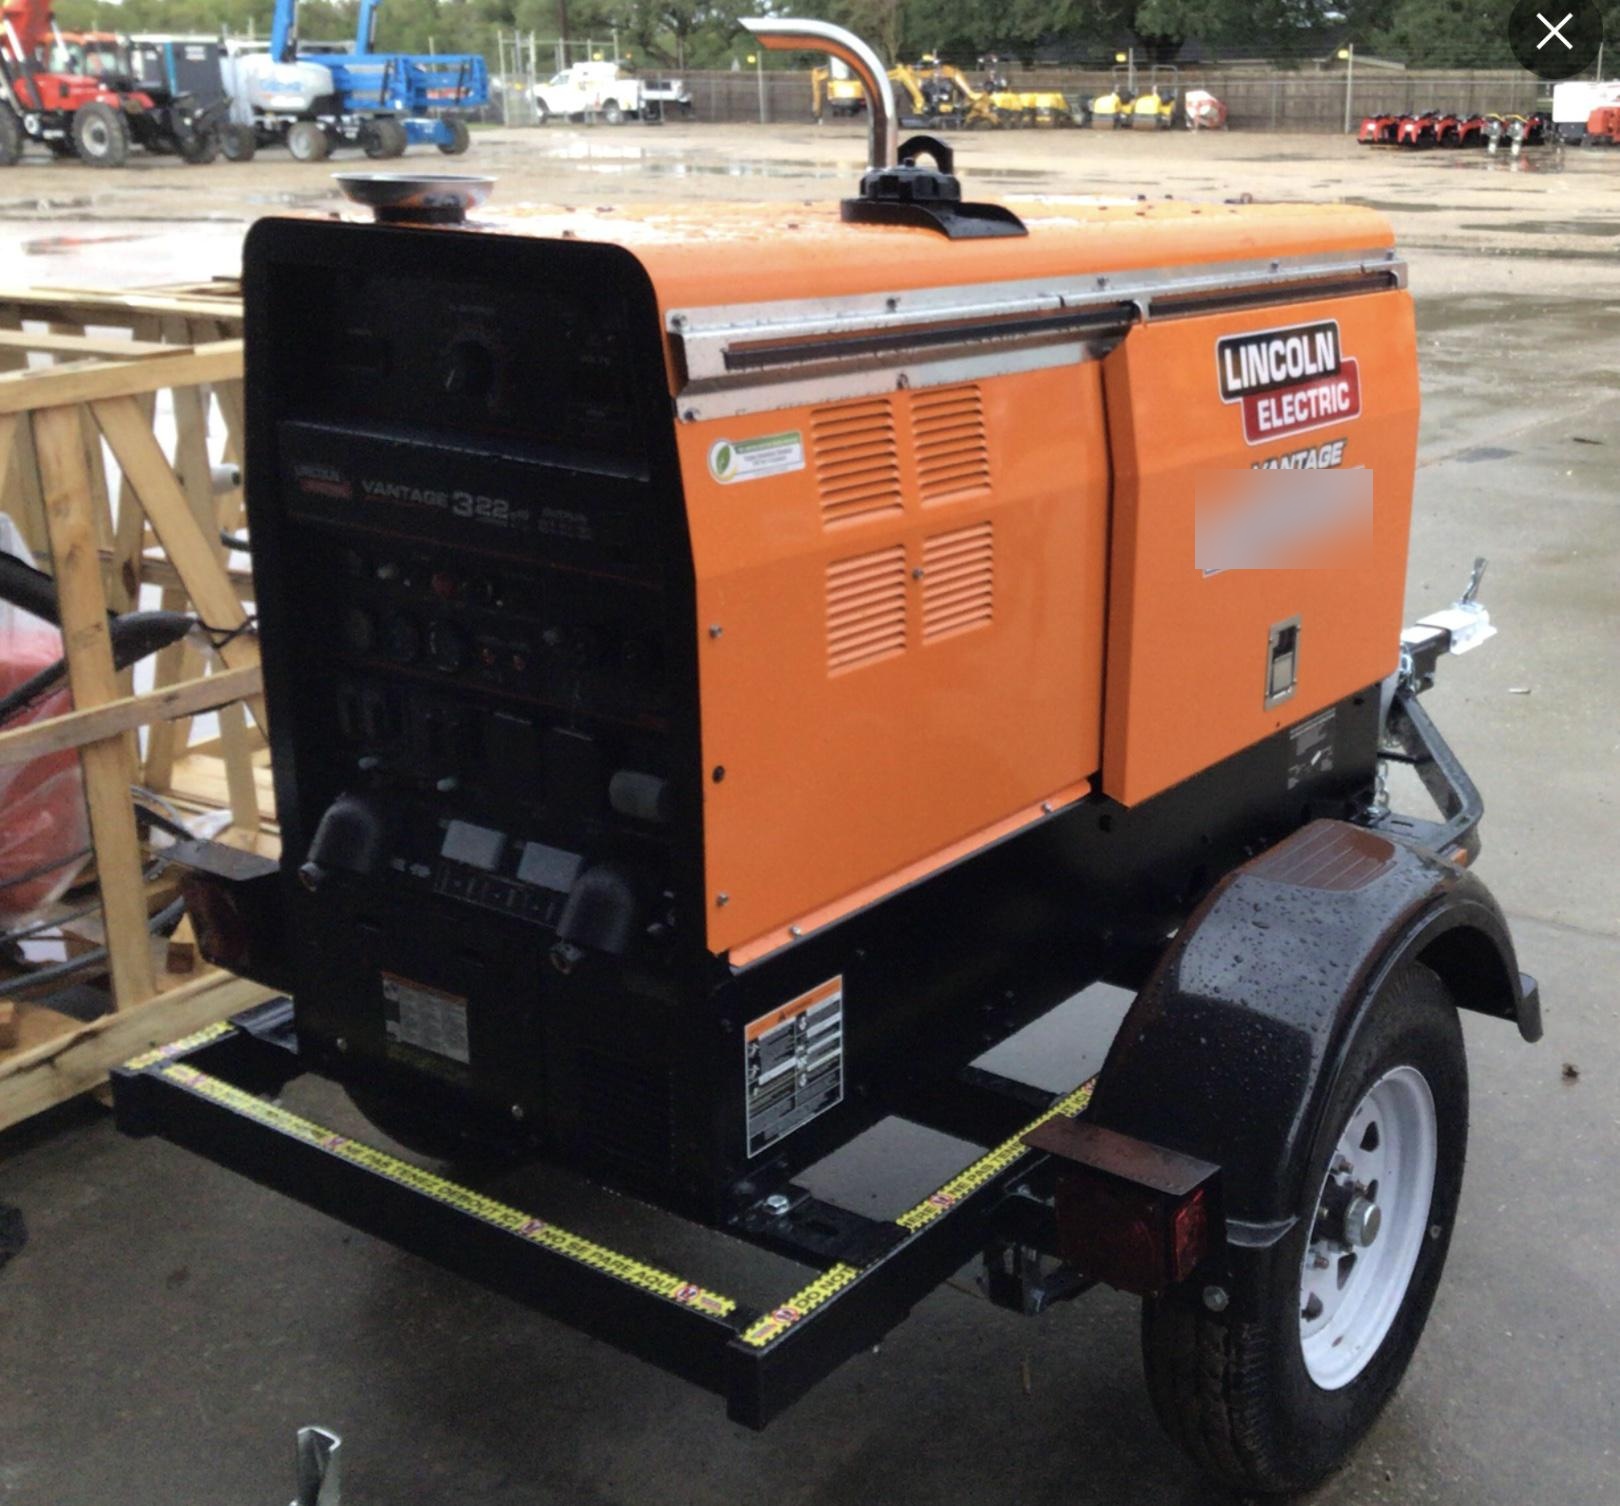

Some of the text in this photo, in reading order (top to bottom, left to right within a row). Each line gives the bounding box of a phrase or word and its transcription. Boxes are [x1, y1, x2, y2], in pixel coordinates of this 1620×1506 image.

[1224, 331, 1336, 391] LINCOLN
[1257, 382, 1350, 431] ELECTRIC
[1252, 440, 1345, 469] NTAGE
[361, 479, 450, 508] VANTAGE
[452, 490, 510, 519] 322
[541, 1229, 566, 1244] NO
[591, 1251, 634, 1273] PARE
[634, 1270, 676, 1292] AQUI
[794, 1266, 857, 1309] DO NOT
